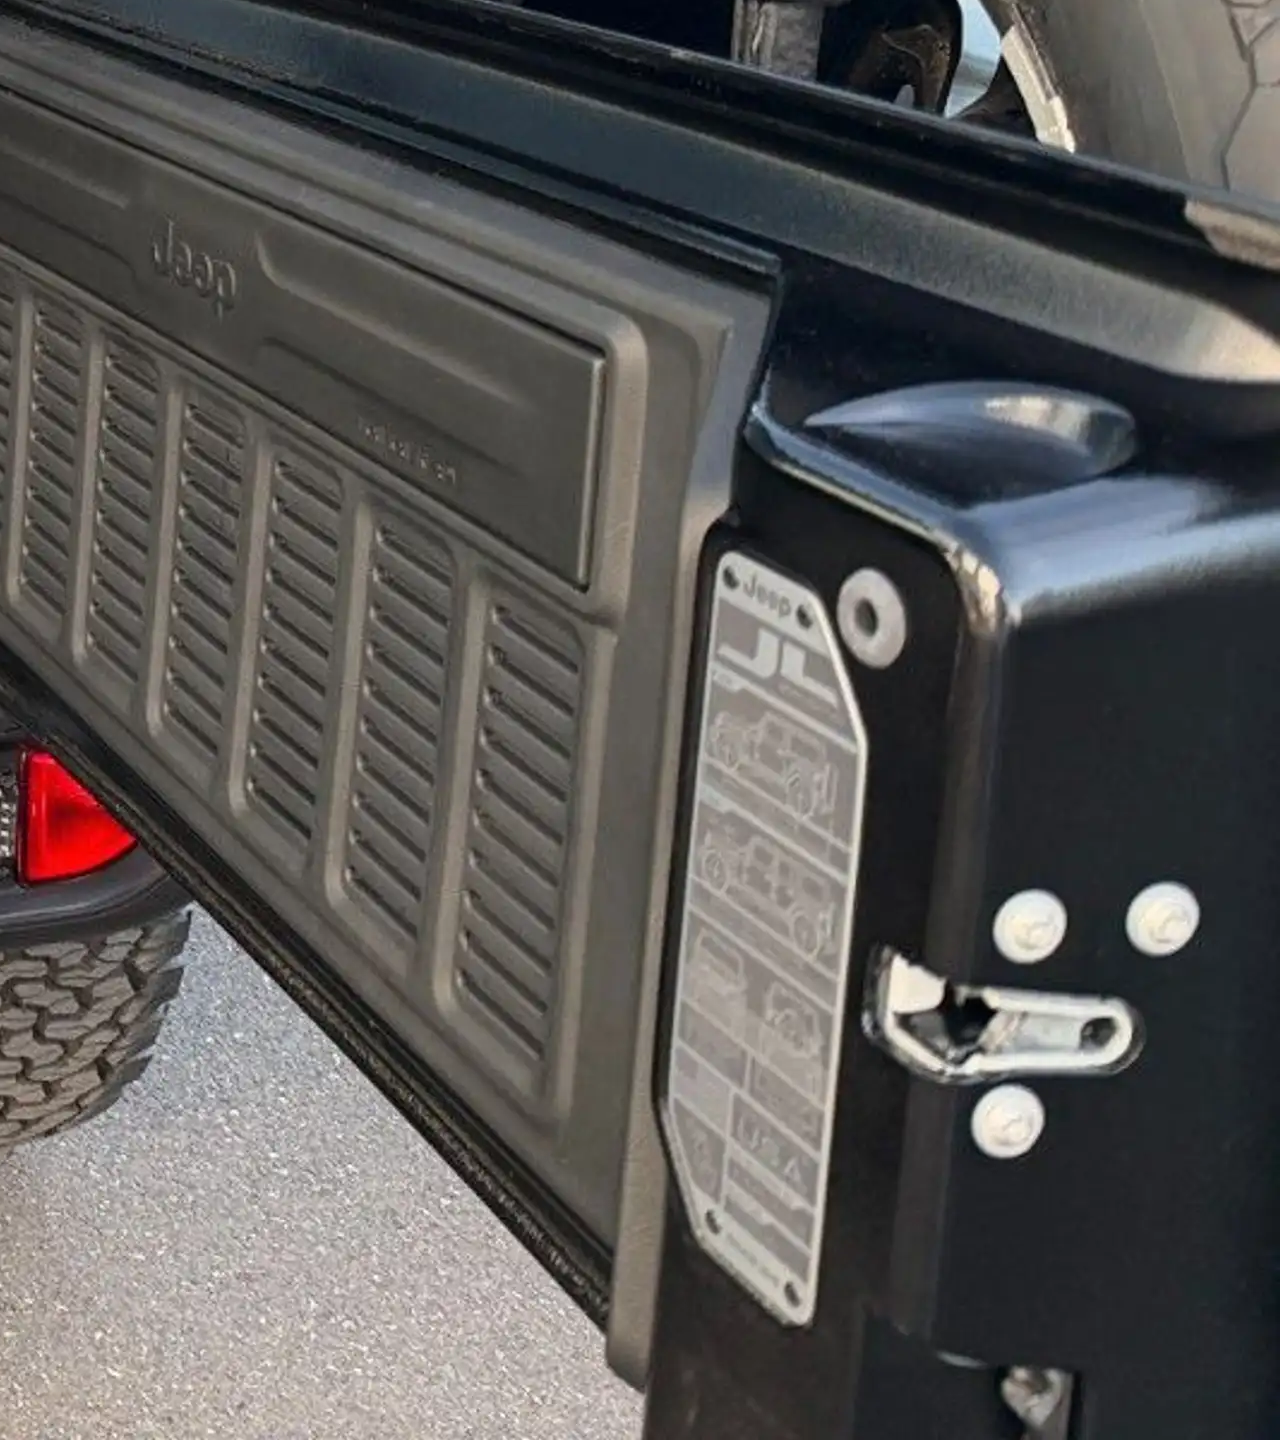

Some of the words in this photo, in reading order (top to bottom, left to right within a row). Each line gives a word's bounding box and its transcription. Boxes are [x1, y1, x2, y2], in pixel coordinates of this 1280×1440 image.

[150, 216, 238, 326] Jeep
[741, 572, 792, 619] Jeep
[717, 627, 839, 709] JL
